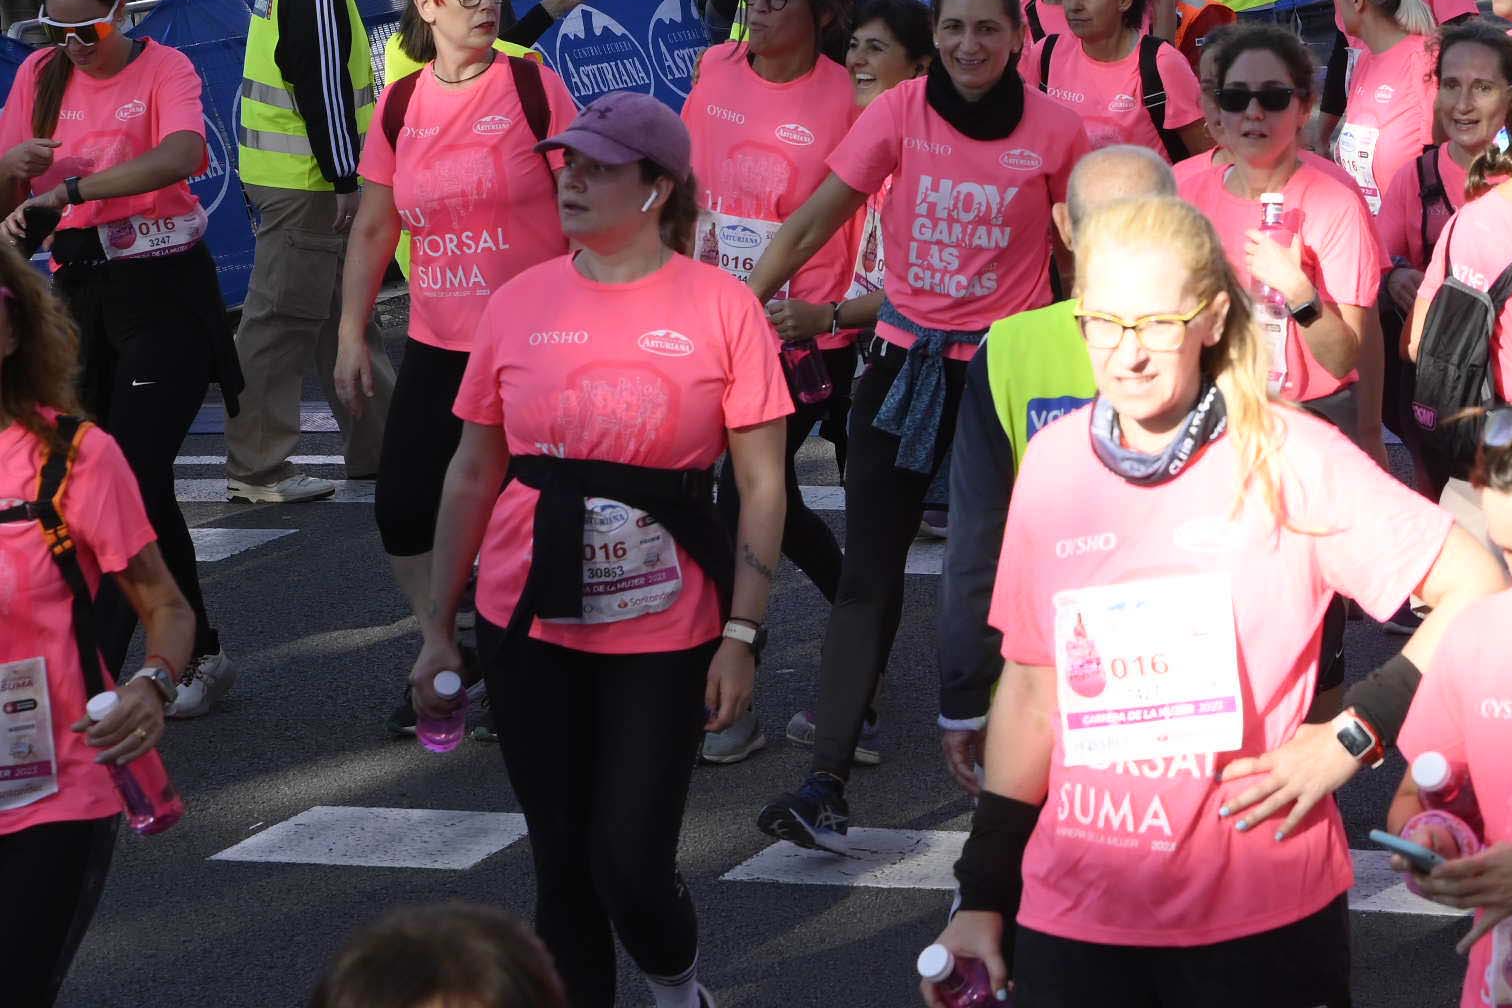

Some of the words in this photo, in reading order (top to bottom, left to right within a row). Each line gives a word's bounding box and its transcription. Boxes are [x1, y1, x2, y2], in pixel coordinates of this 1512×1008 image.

[572, 46, 603, 60] CENTRAL
[602, 41, 633, 55] LECHERA
[564, 52, 650, 97] ASTURIANA
[1047, 87, 1085, 104] OYSHO
[59, 110, 85, 121] SHO
[707, 104, 745, 125] OYSHO
[903, 137, 953, 156] OYSHO
[915, 175, 1019, 222] HOY
[138, 218, 176, 236] 016
[912, 217, 1012, 250] GANAN
[149, 236, 172, 248] 3247
[721, 253, 754, 272] 016
[908, 242, 960, 271] LAS
[418, 264, 487, 289] SUMA
[907, 265, 998, 299] CHICAS
[529, 329, 589, 346] OYSHO
[641, 337, 692, 353] ASTURIANA
[584, 541, 628, 562] 016
[1110, 654, 1169, 680] 016
[1057, 782, 1173, 837] SUMA
